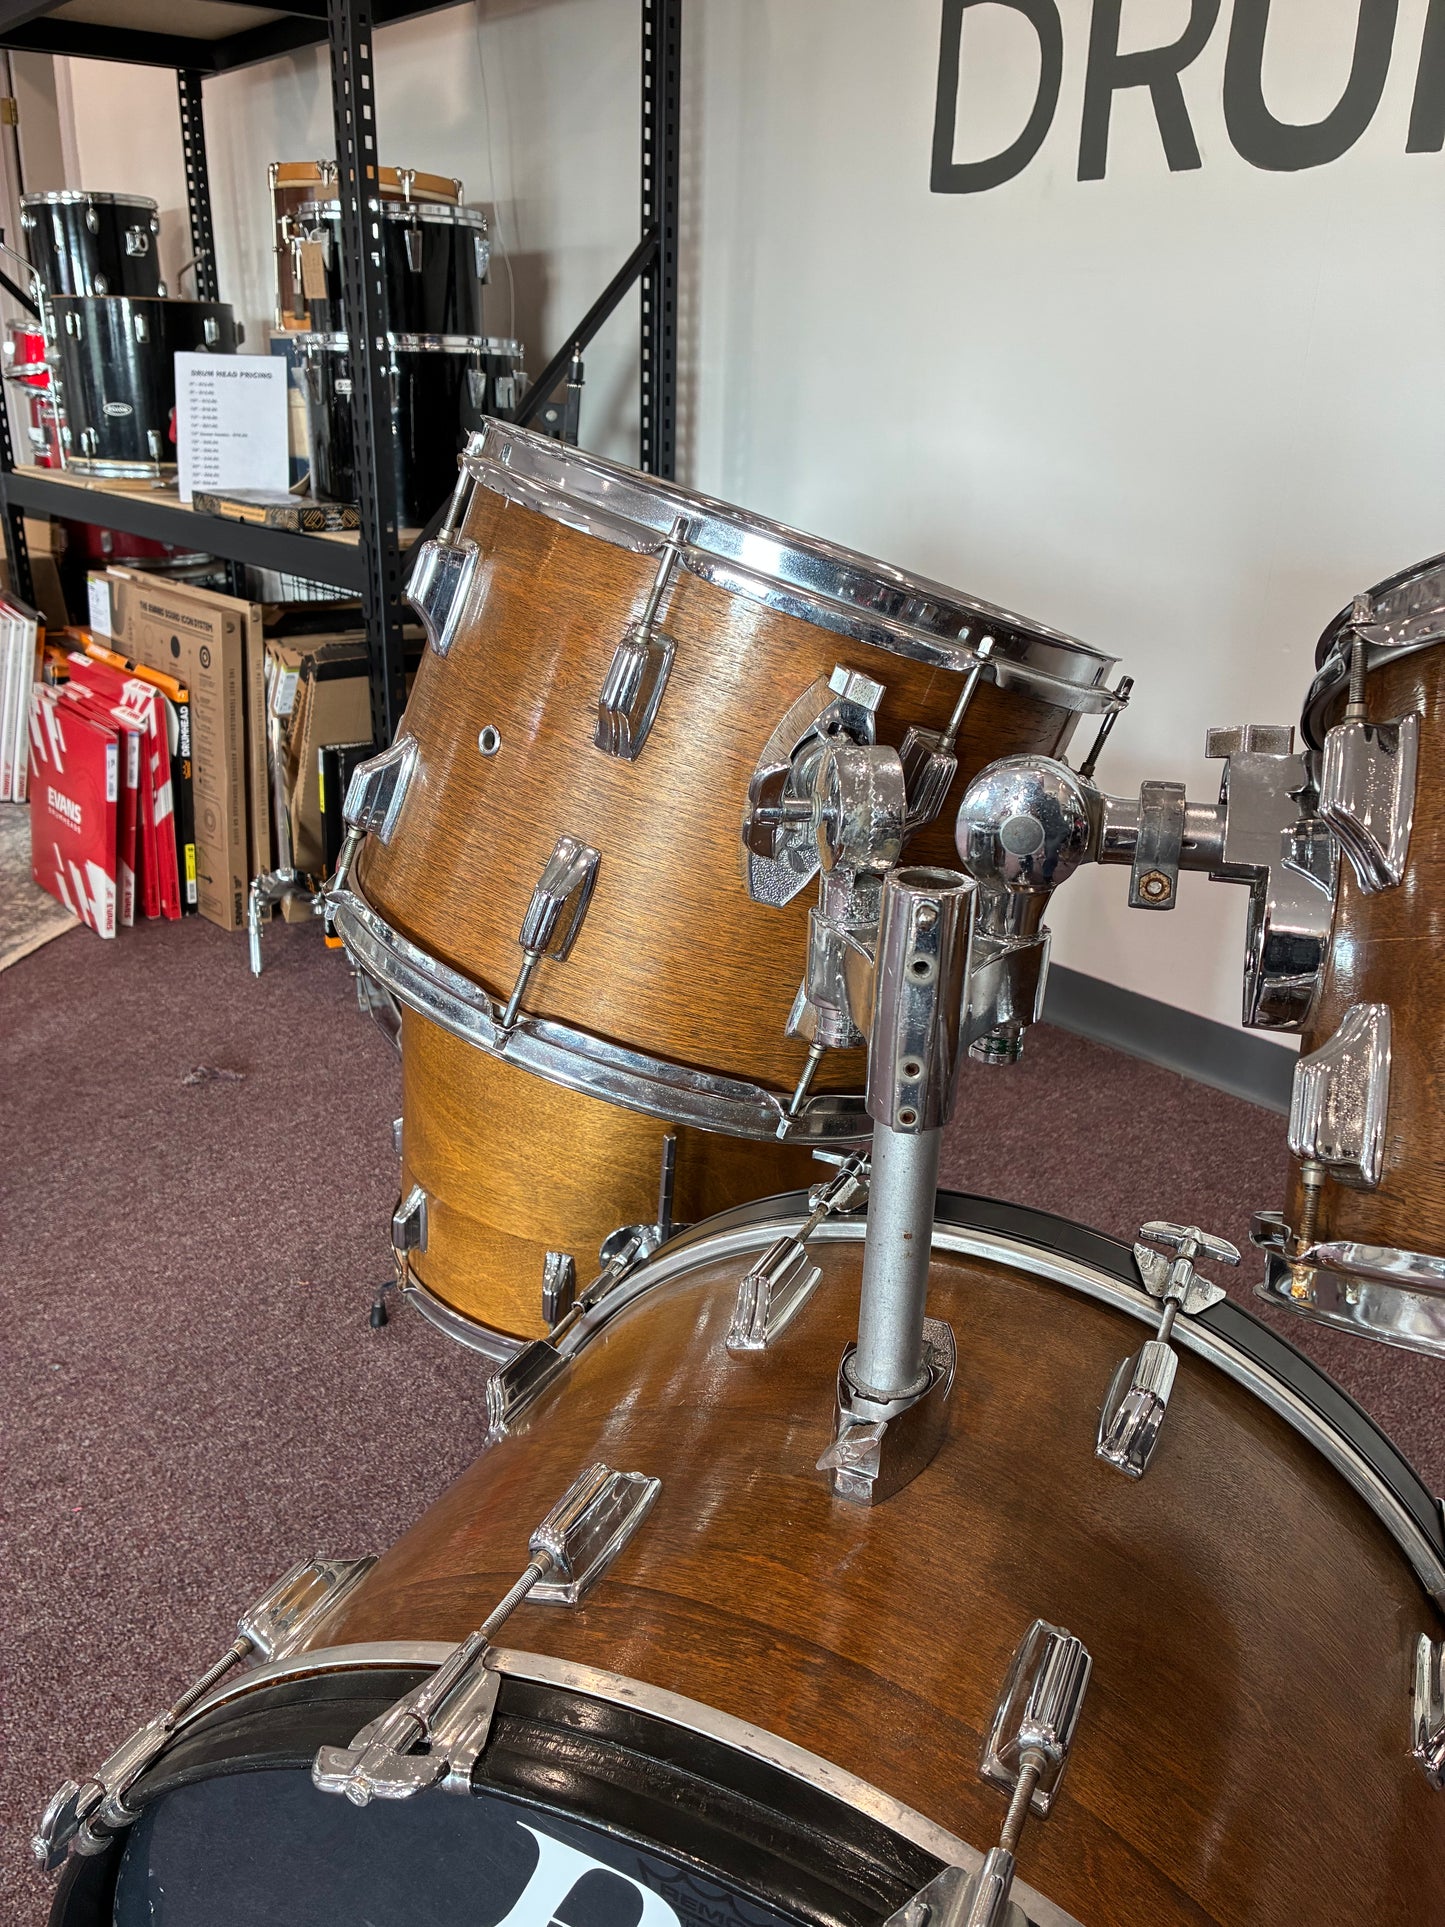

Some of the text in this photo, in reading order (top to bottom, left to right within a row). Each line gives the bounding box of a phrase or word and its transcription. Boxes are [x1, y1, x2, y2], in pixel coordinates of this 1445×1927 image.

[240, 371, 273, 379] PRICING
[180, 706, 190, 757] DRUMHEAD
[48, 785, 82, 825] EVANS
[234, 892, 243, 926] EVANS
